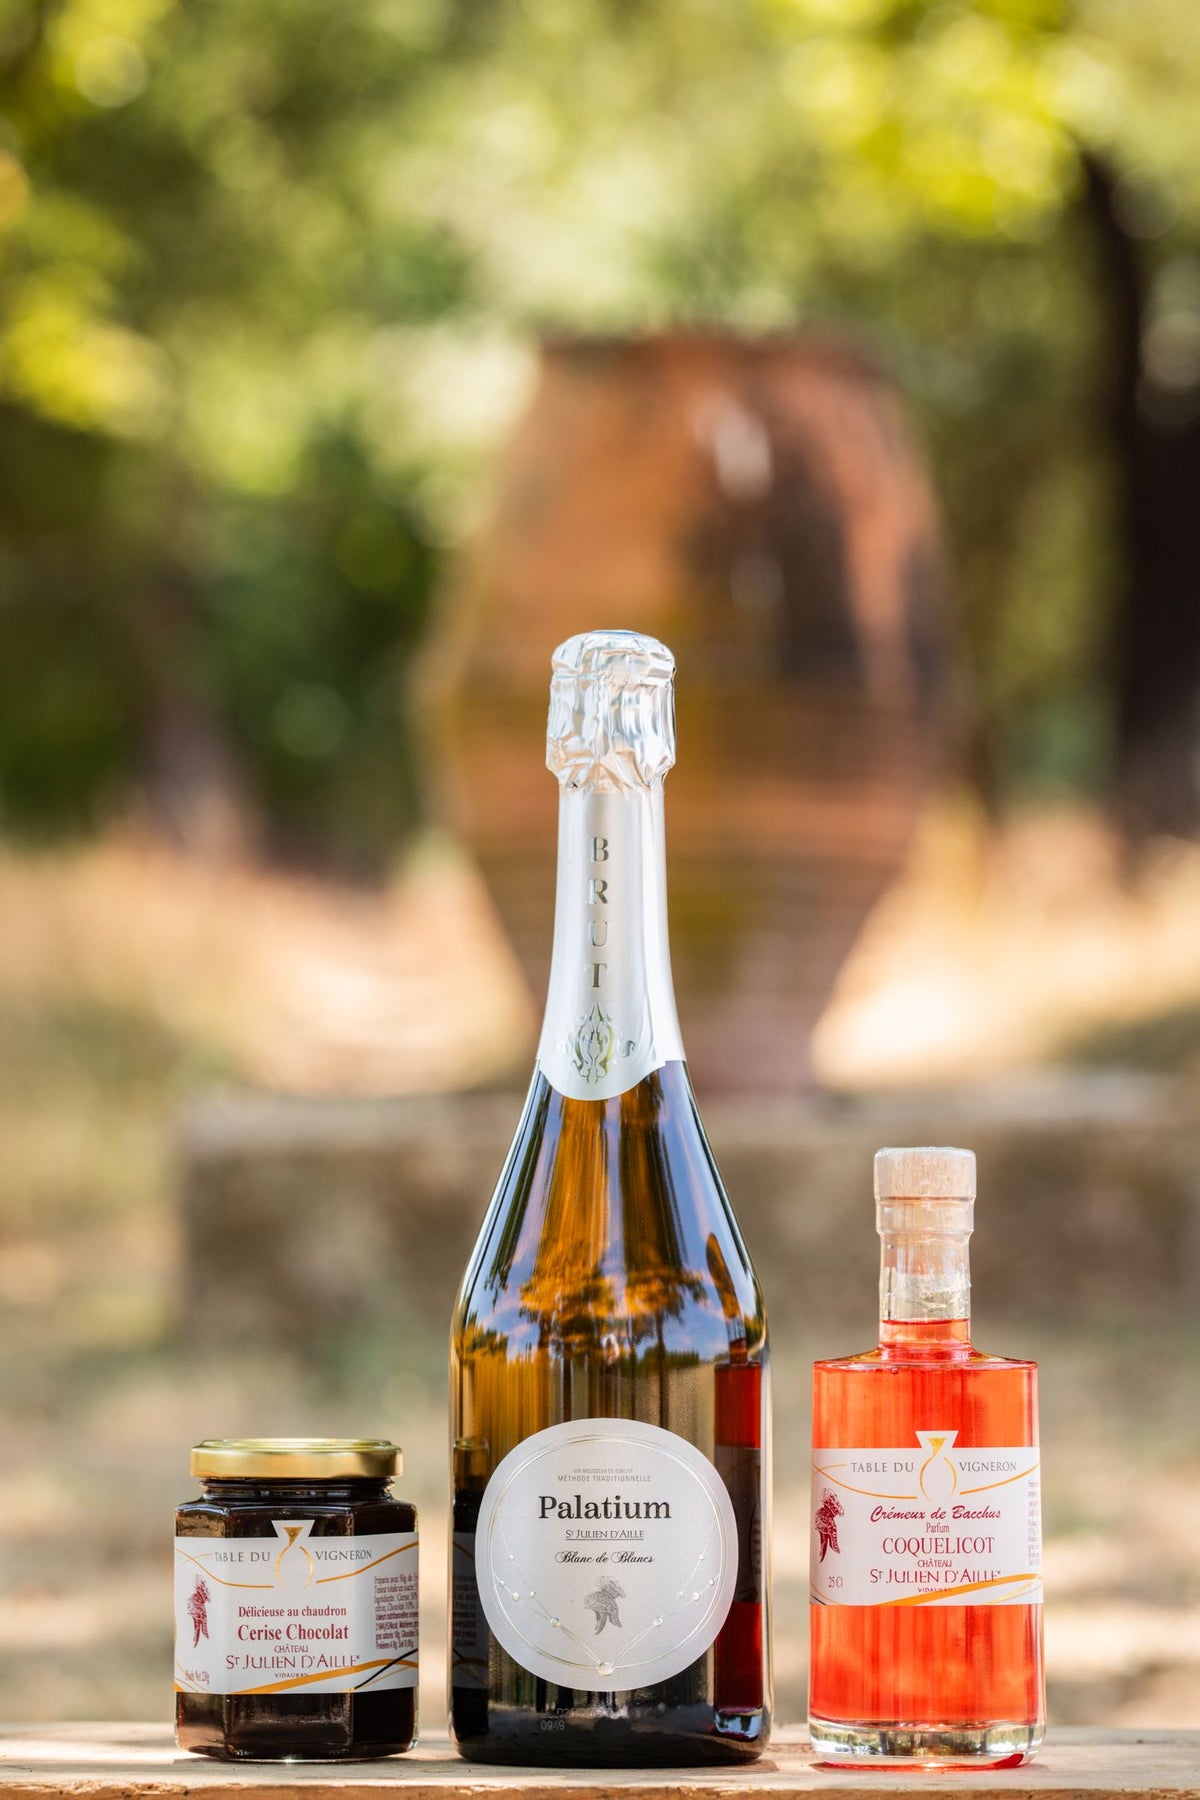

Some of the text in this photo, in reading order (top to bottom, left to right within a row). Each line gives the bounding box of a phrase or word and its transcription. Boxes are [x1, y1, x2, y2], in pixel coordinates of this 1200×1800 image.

[588, 836, 609, 988] BRUT
[851, 1461, 1017, 1473] TABLE DU VIGNERON
[538, 1494, 672, 1519] Palatium
[870, 1505, 1001, 1523] Crémeux de Bacchus
[576, 1529, 608, 1539] JULIEN
[925, 1522, 950, 1533] Parfum
[882, 1536, 996, 1557] COQUELICOT
[214, 1549, 373, 1562] TABLE DU VIGNERON
[555, 1551, 655, 1563] Blanc de Blancs
[917, 1557, 952, 1568] CHÂTEAU
[886, 1569, 939, 1584] JULIEN
[238, 1605, 347, 1618] Délicieuse au chaudron
[237, 1623, 349, 1641] Cerise Chocolat
[274, 1643, 309, 1653] CHÂTEAU
[242, 1654, 296, 1670] JULIEN
